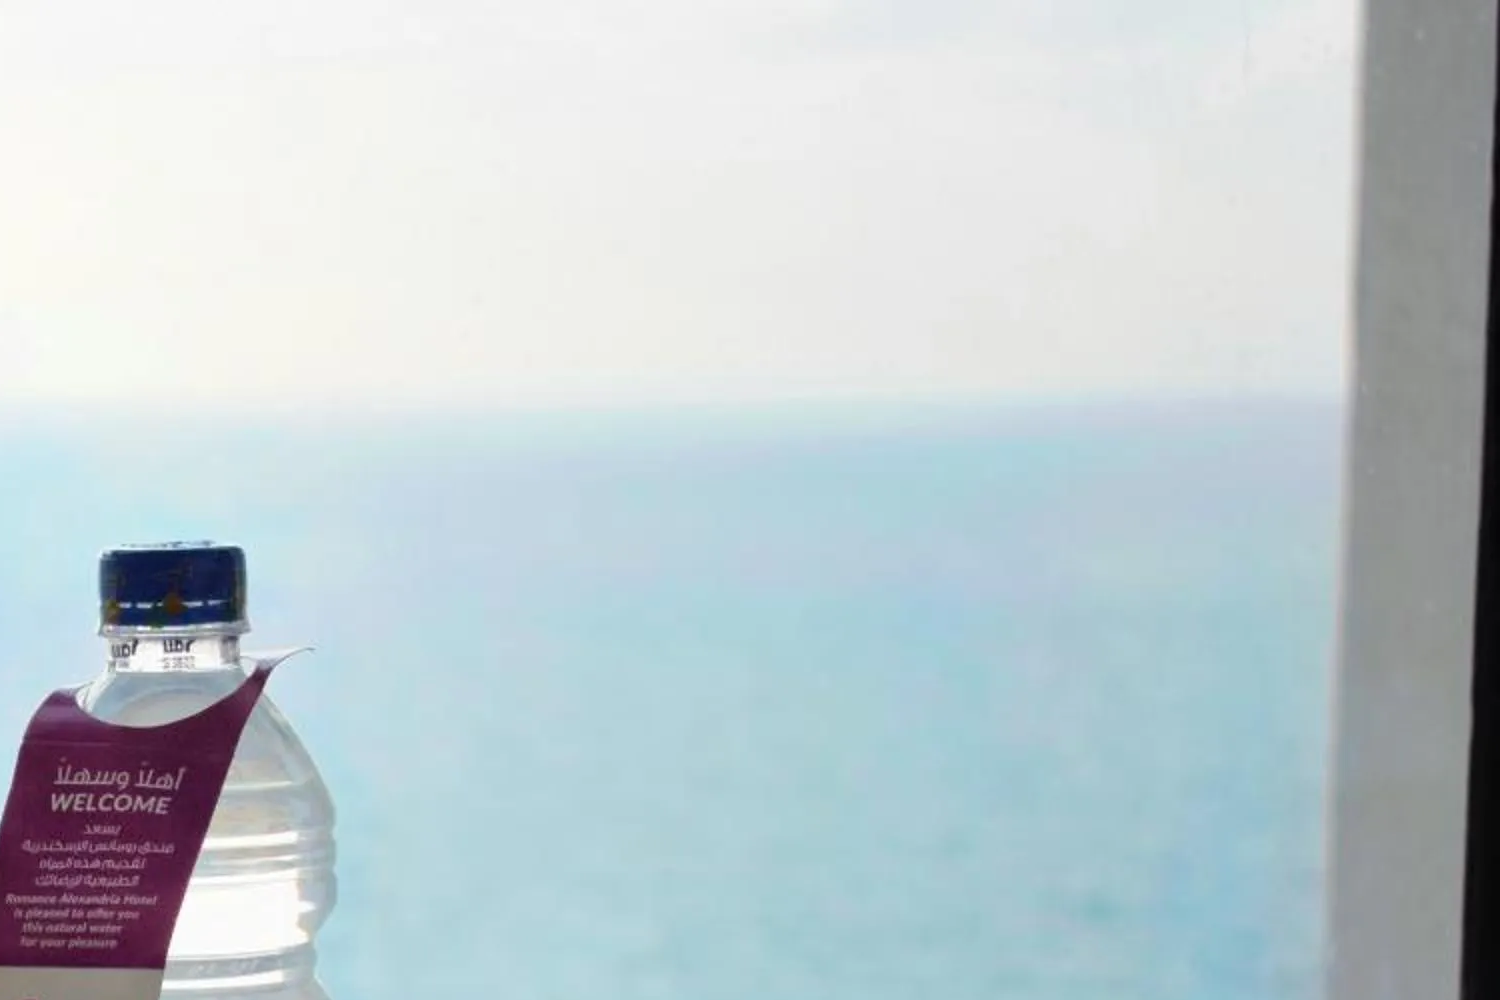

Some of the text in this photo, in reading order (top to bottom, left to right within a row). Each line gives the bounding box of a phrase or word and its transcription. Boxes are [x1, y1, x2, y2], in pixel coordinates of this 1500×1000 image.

[51, 793, 172, 815] WELCOME
[59, 893, 120, 905] Alexandria
[123, 894, 158, 906] Hotel
[25, 908, 70, 920] pleased
[71, 909, 85, 919] to
[86, 908, 114, 919] offer
[116, 910, 141, 921] you
[23, 922, 123, 933] this natural water
[19, 936, 119, 949] for your pleasure
